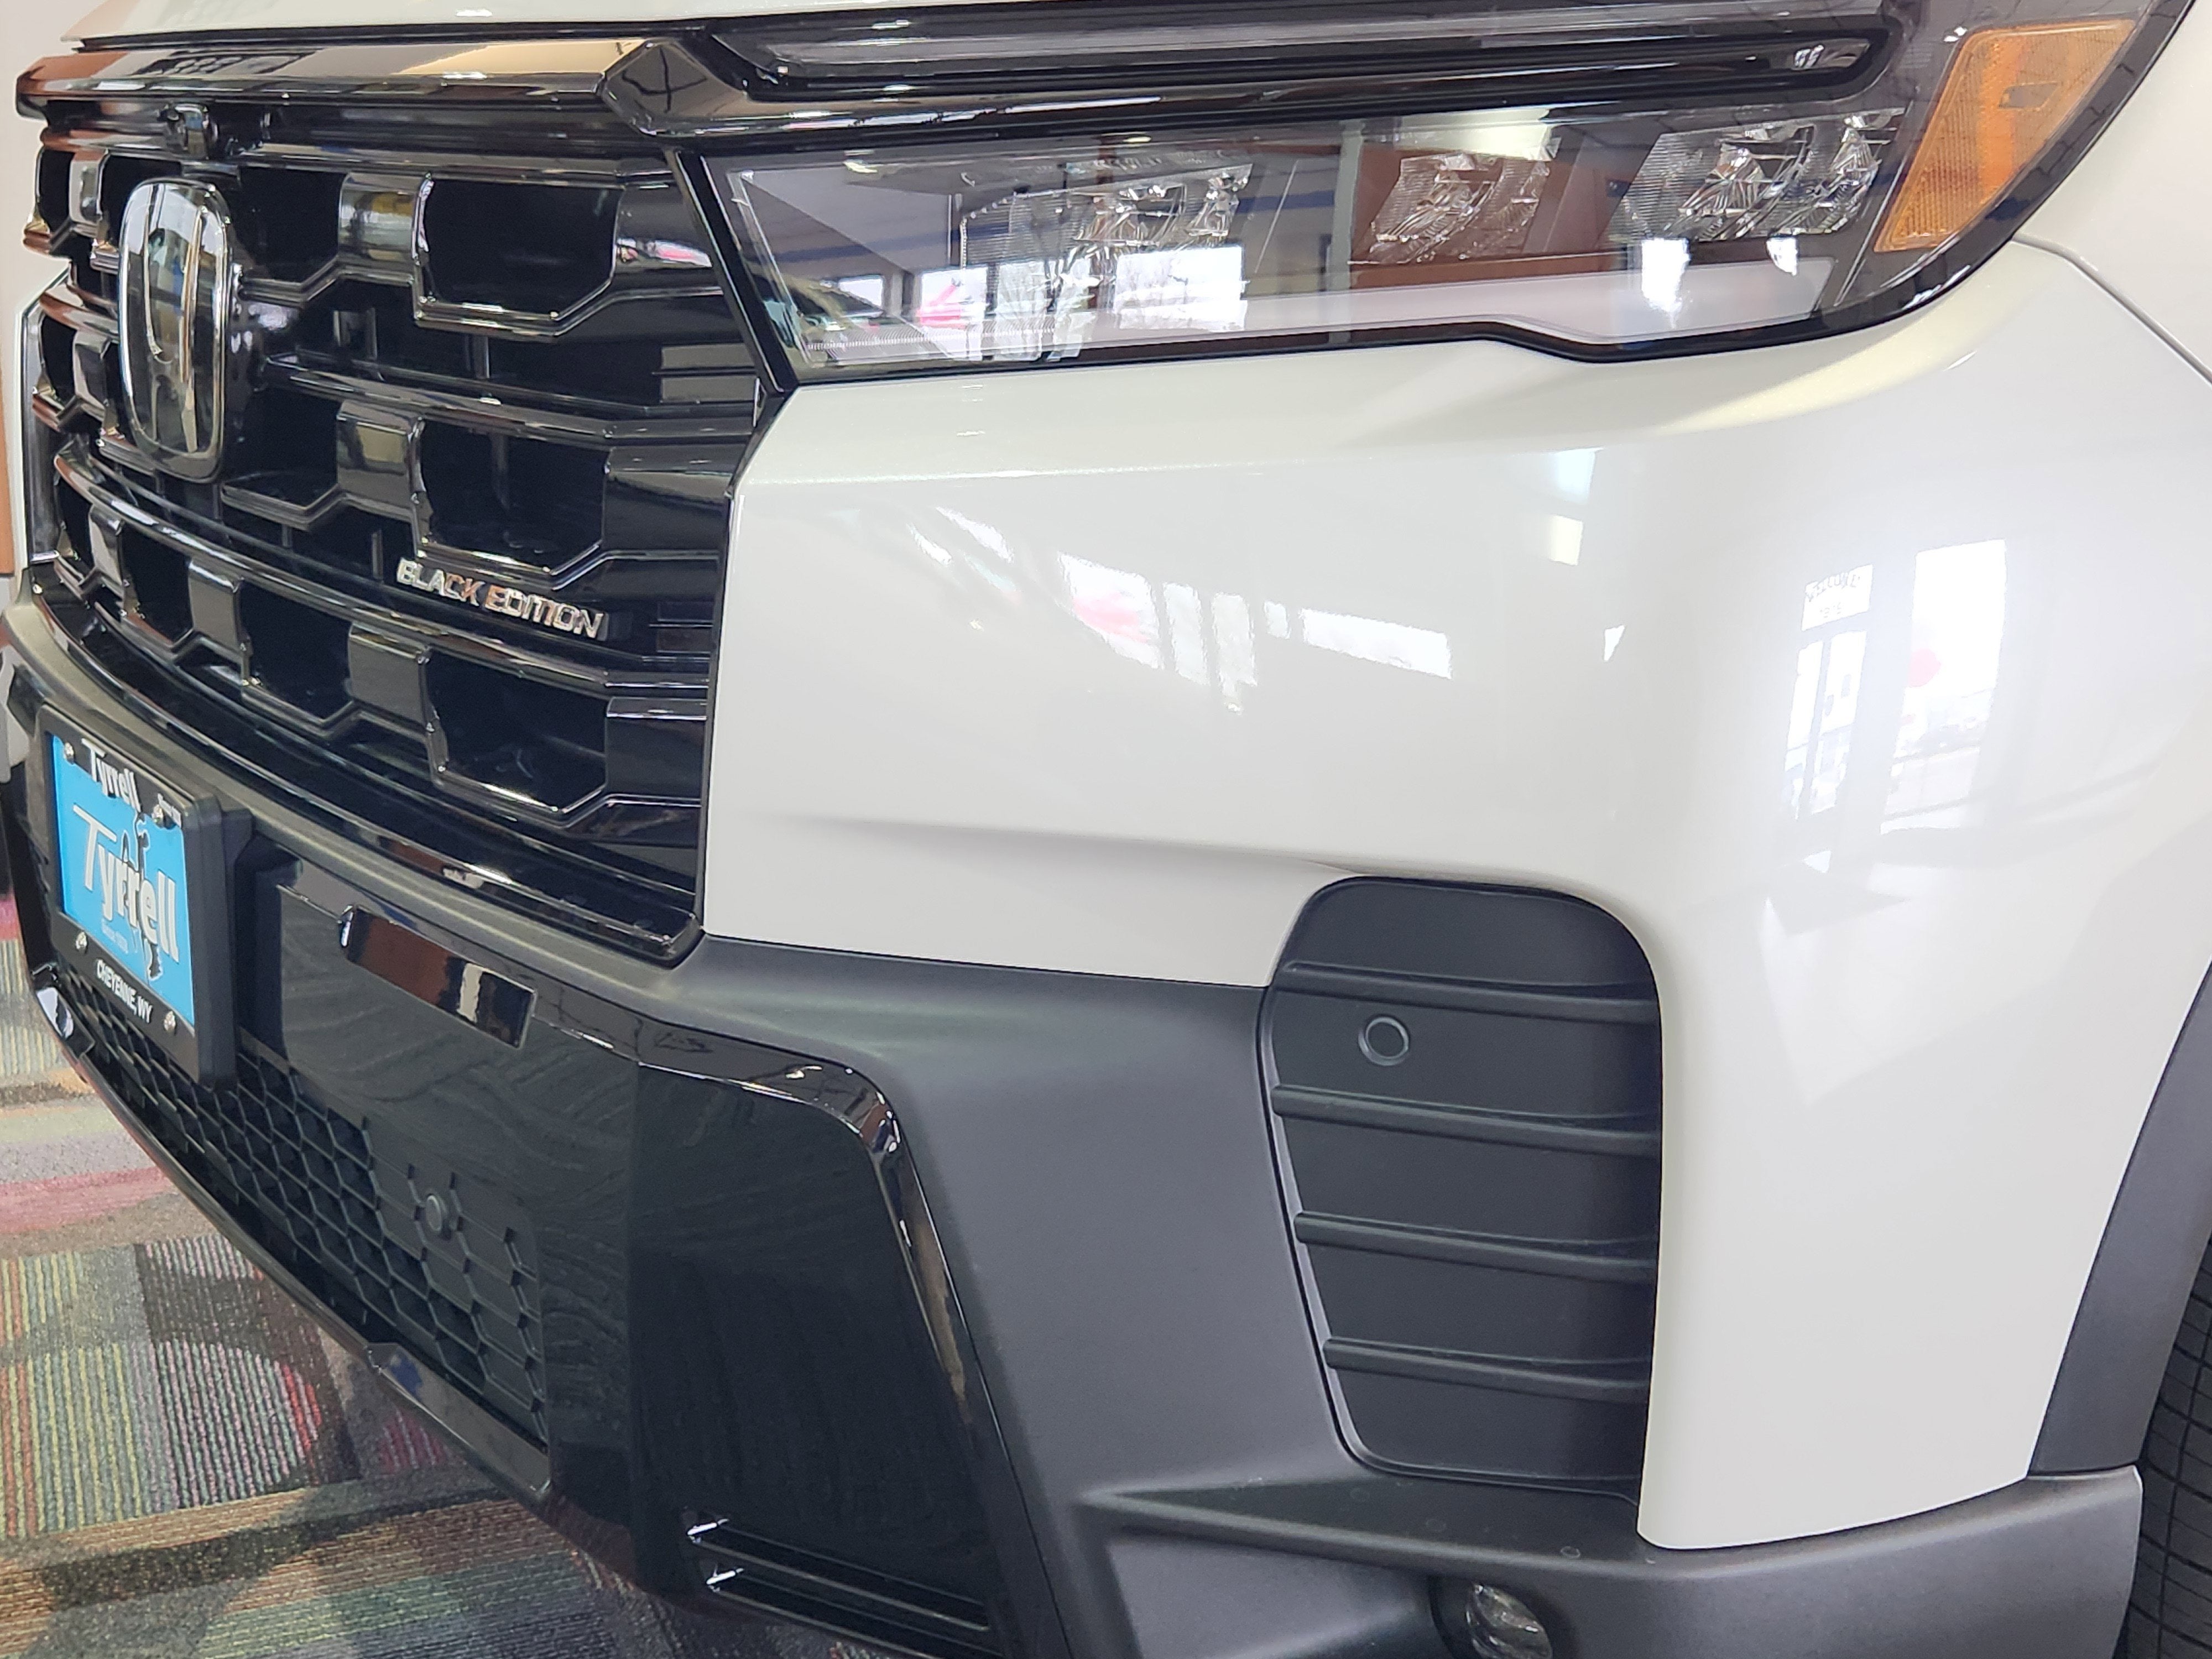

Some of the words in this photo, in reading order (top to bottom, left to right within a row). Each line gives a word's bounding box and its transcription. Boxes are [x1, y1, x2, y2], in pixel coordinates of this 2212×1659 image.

[397, 557, 485, 606] BLACK
[484, 585, 603, 639] EDITION
[81, 738, 142, 812] Tyrrell
[73, 804, 179, 963] Tyrrell
